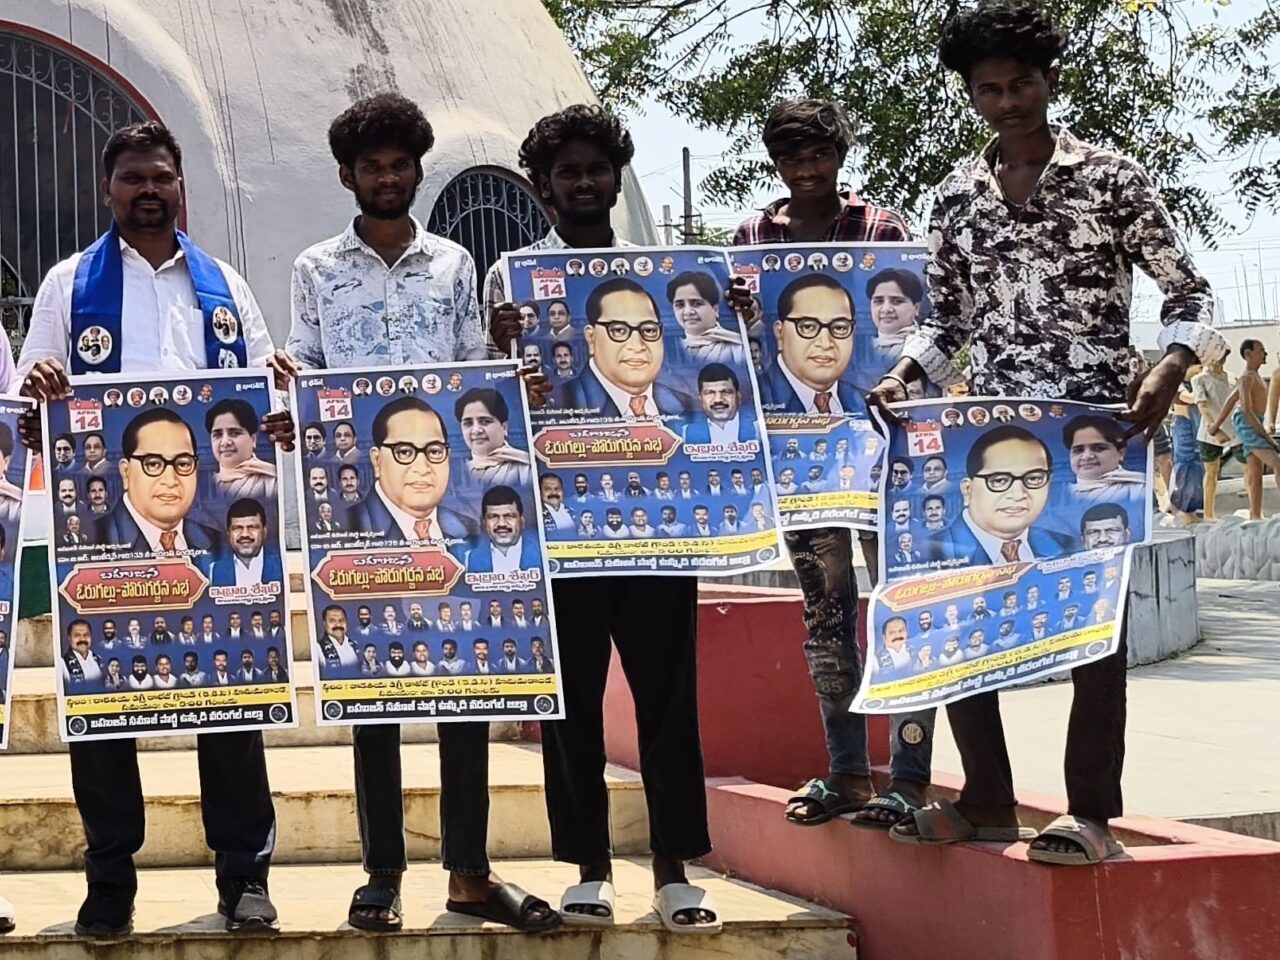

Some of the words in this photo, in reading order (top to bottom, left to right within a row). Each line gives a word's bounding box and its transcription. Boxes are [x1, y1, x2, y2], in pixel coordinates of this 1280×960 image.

[538, 284, 563, 297] 14
[324, 404, 349, 418] 14
[75, 415, 100, 429] 14
[914, 438, 940, 453] 14
